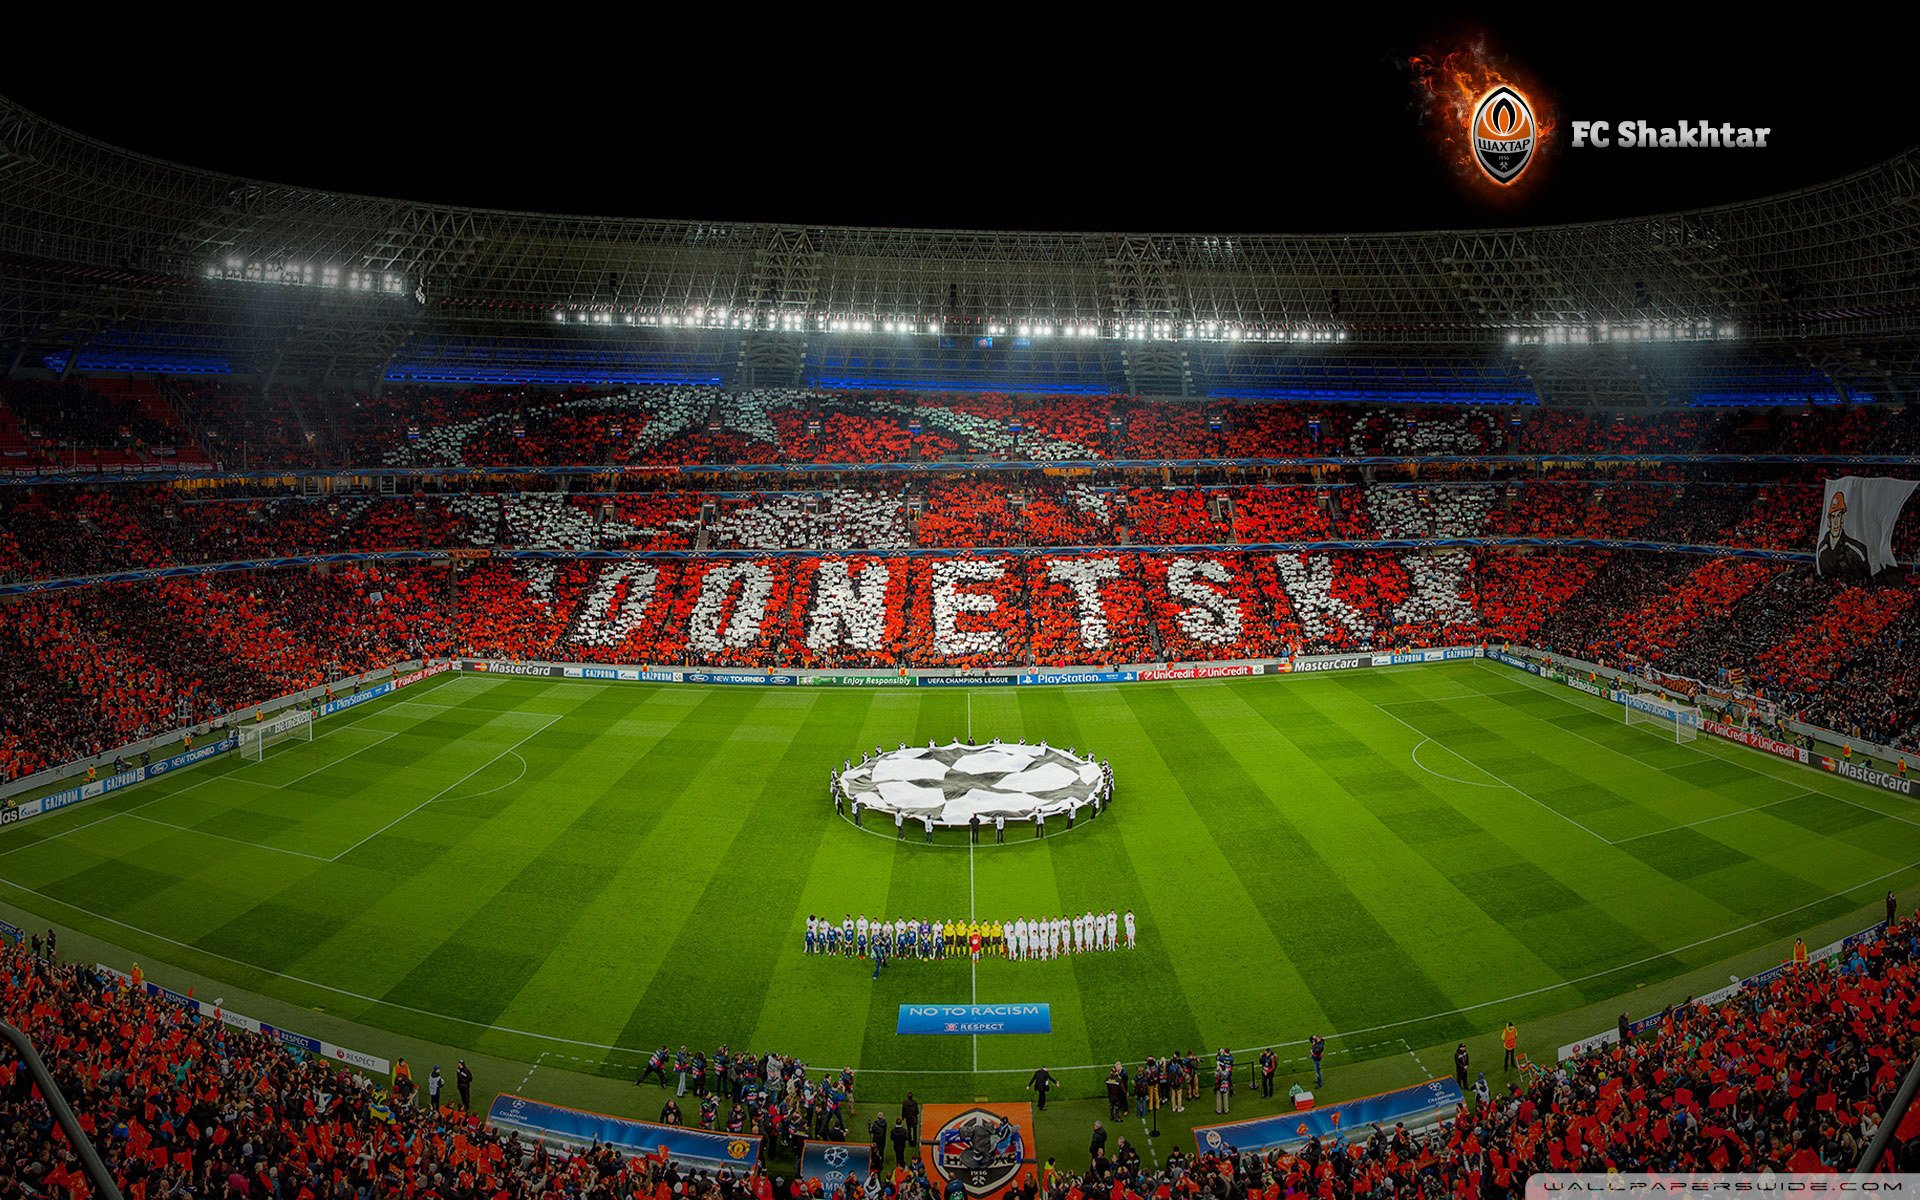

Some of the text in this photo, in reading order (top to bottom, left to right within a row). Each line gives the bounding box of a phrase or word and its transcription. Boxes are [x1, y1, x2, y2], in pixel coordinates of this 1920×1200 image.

[1294, 658, 1359, 672] MasterCard
[1394, 654, 1422, 663] GAZPROM
[489, 661, 550, 676] MasterCard
[585, 669, 615, 679] GAZPROM
[1153, 669, 1195, 680] UniCredit
[1208, 666, 1248, 677] UniCredit
[641, 671, 672, 681] GAZPROM
[842, 676, 911, 685] Enjoy Responsibly
[984, 676, 1008, 684] LEAGUE
[1567, 674, 1600, 696] Heineken
[1714, 723, 1748, 744] UniCredit
[1758, 736, 1795, 759] UniCredit
[171, 746, 215, 768] NEW TOURNEO
[106, 770, 137, 790] GAZPROM
[1838, 760, 1911, 794] MasterCard
[45, 790, 79, 810] GAZPROM
[909, 1006, 1039, 1017] NO TO RACISM
[960, 1023, 1004, 1031] RESPECT
[280, 1032, 309, 1047] RESPECT
[346, 1052, 375, 1067] RESPECT
